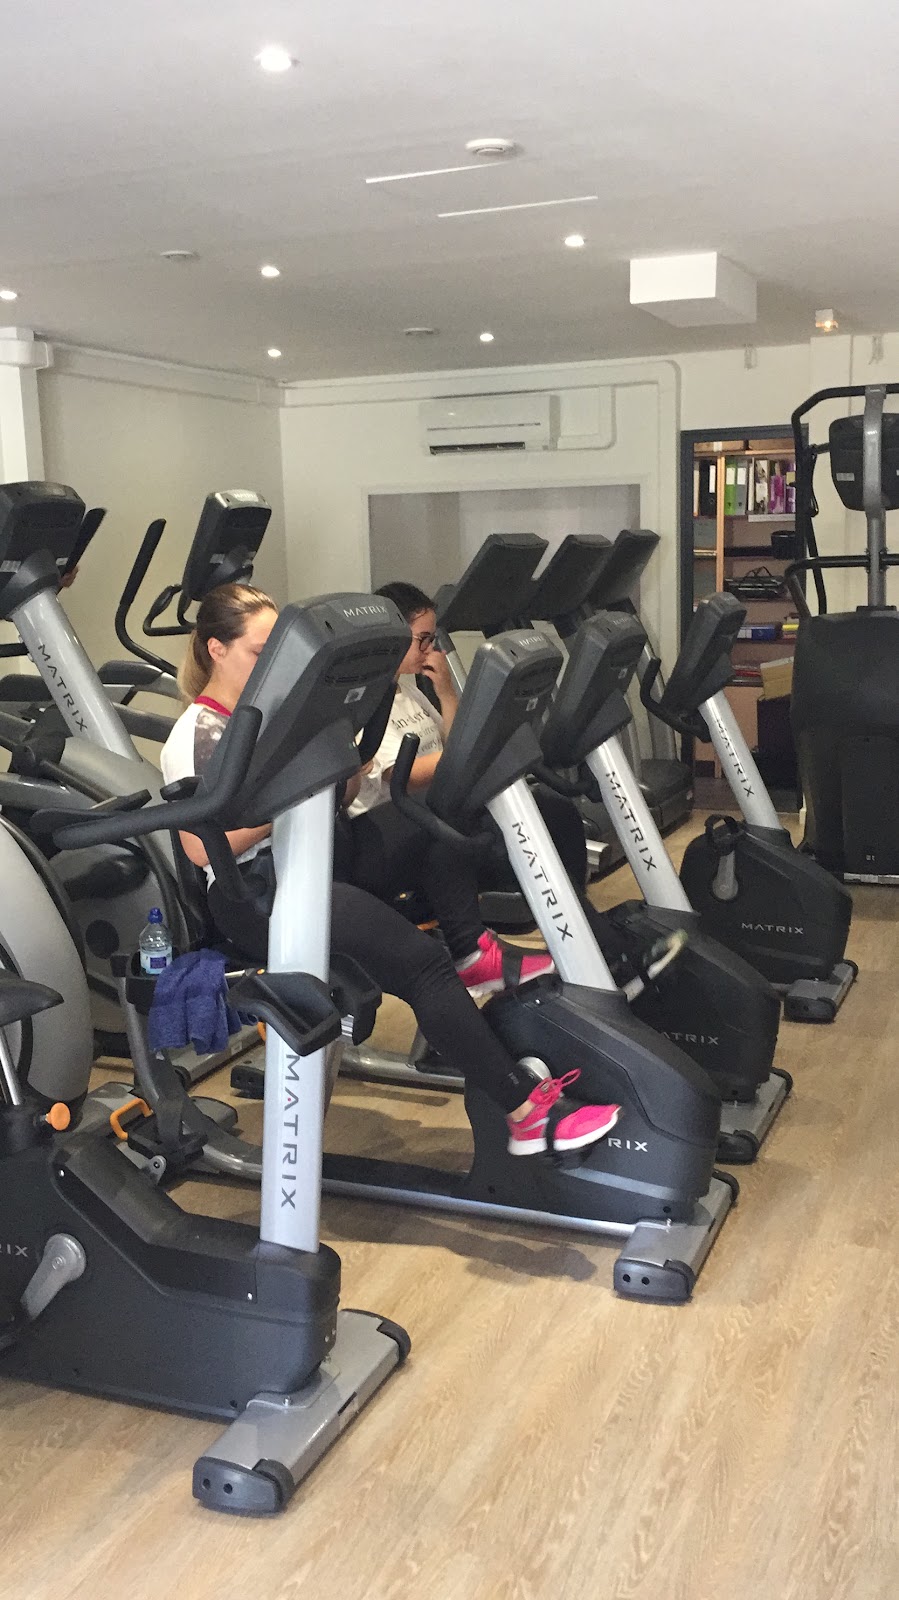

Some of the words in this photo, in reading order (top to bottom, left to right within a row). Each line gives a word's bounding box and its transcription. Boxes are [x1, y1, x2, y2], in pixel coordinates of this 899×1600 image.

[343, 605, 388, 617] MATRIX
[38, 644, 88, 732] MATRIX
[605, 771, 657, 872] MATRIX
[512, 821, 573, 942] MATRIX
[741, 922, 804, 935] MATRIX
[281, 1053, 301, 1210] MATRIX
[607, 1137, 649, 1152] RIX
